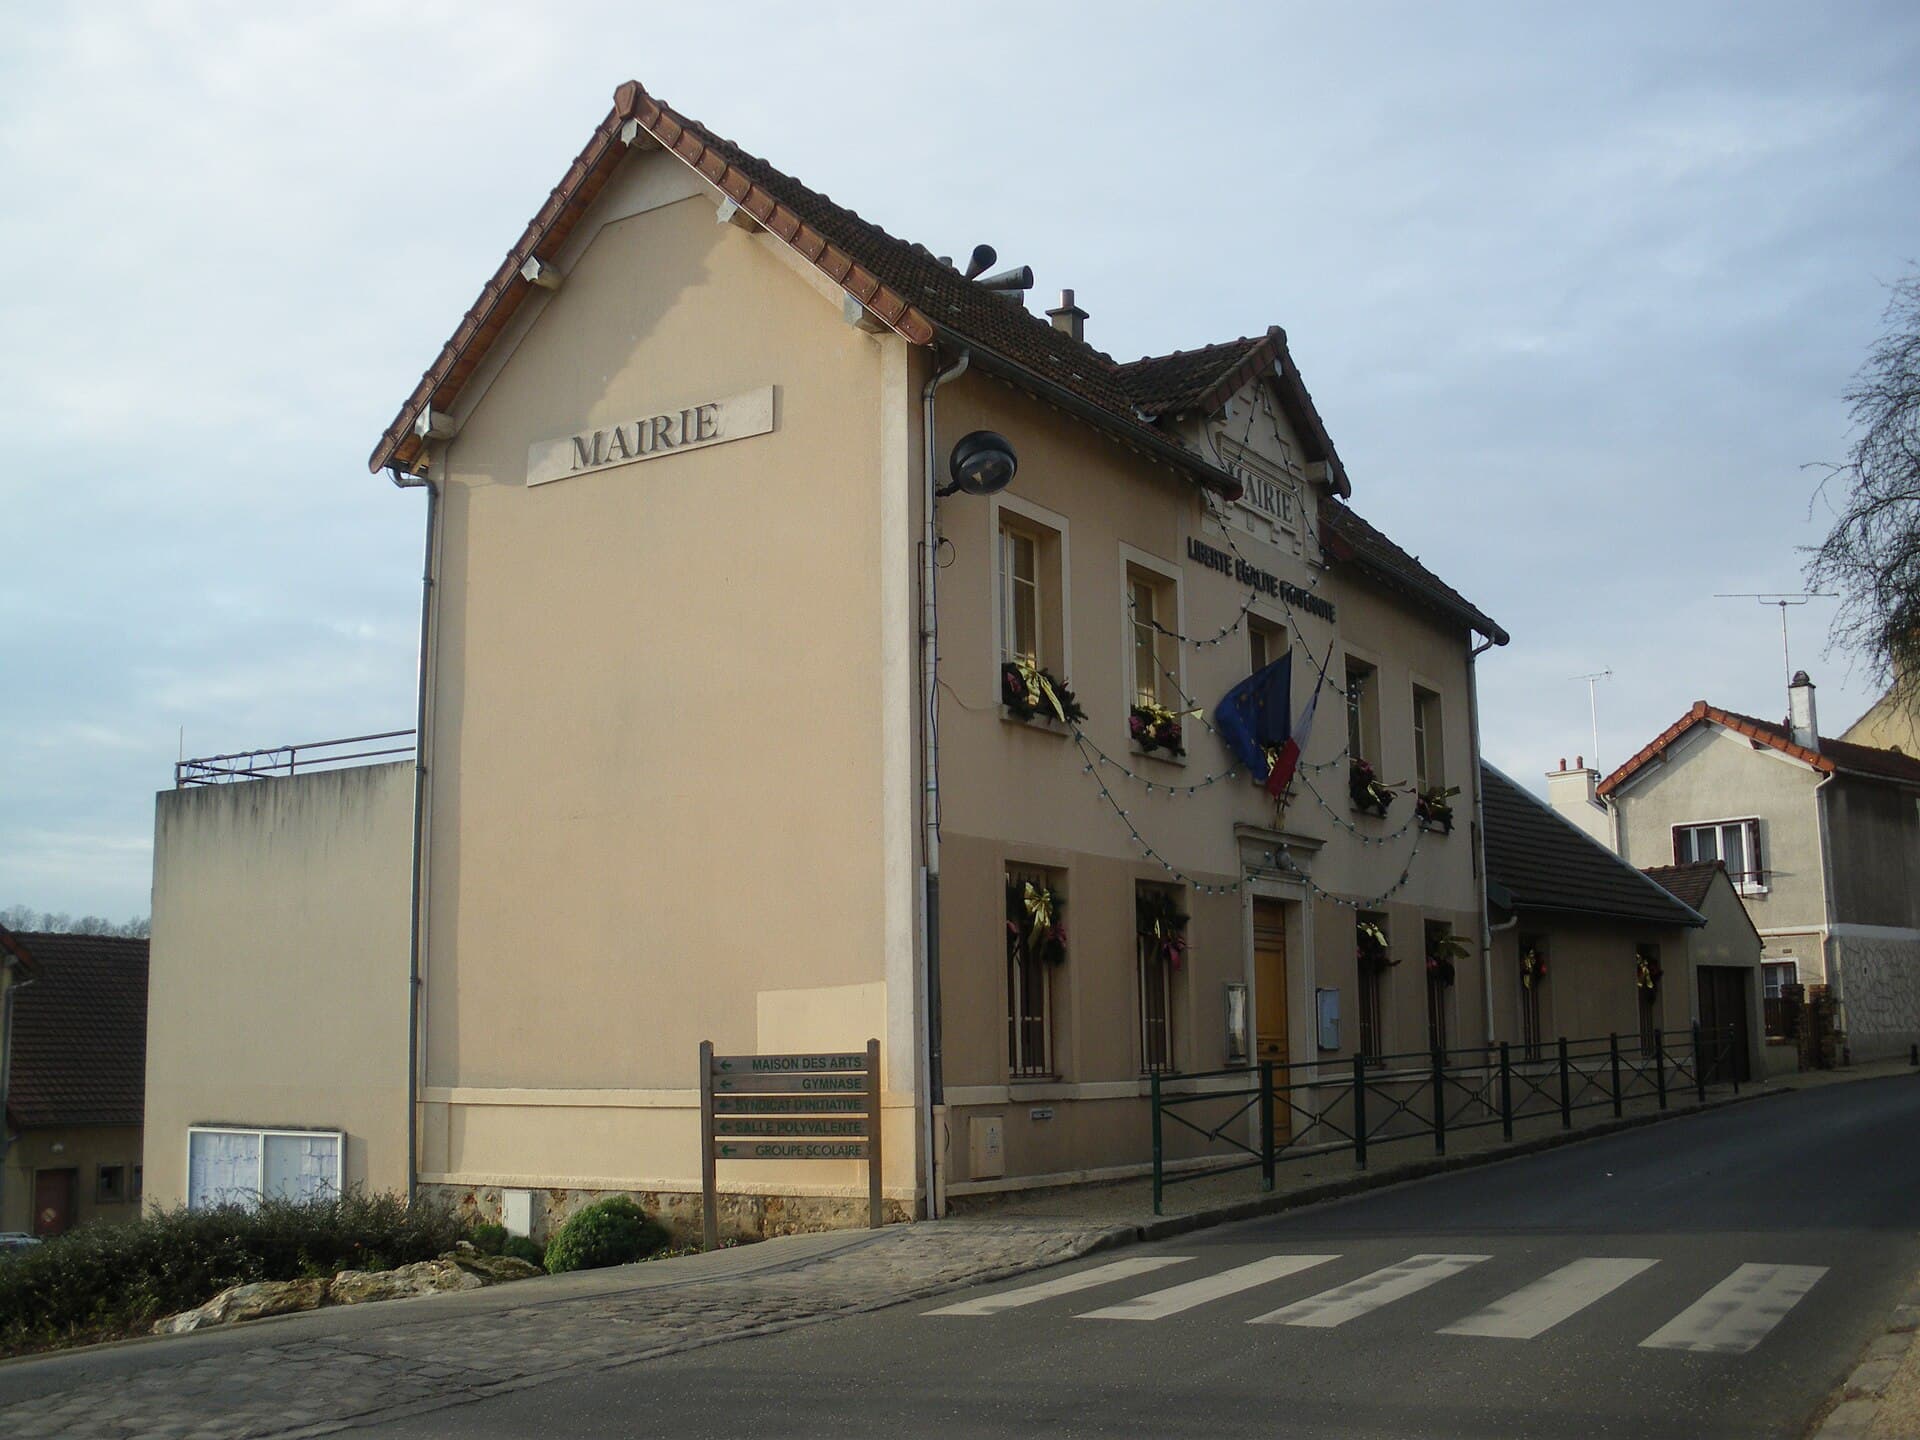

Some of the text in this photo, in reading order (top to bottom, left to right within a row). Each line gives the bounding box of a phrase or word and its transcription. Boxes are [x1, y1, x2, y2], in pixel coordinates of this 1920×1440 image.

[570, 402, 719, 471] MAIRIE
[752, 1056, 862, 1071] MAISON DES ARTS
[802, 1078, 862, 1090] GYMNASE
[735, 1098, 862, 1112] SYNDICAT D'INITIATIVE
[735, 1121, 862, 1134] SALLE POLYVALENTE
[755, 1144, 862, 1157] GROUPE SCOLAIRE
